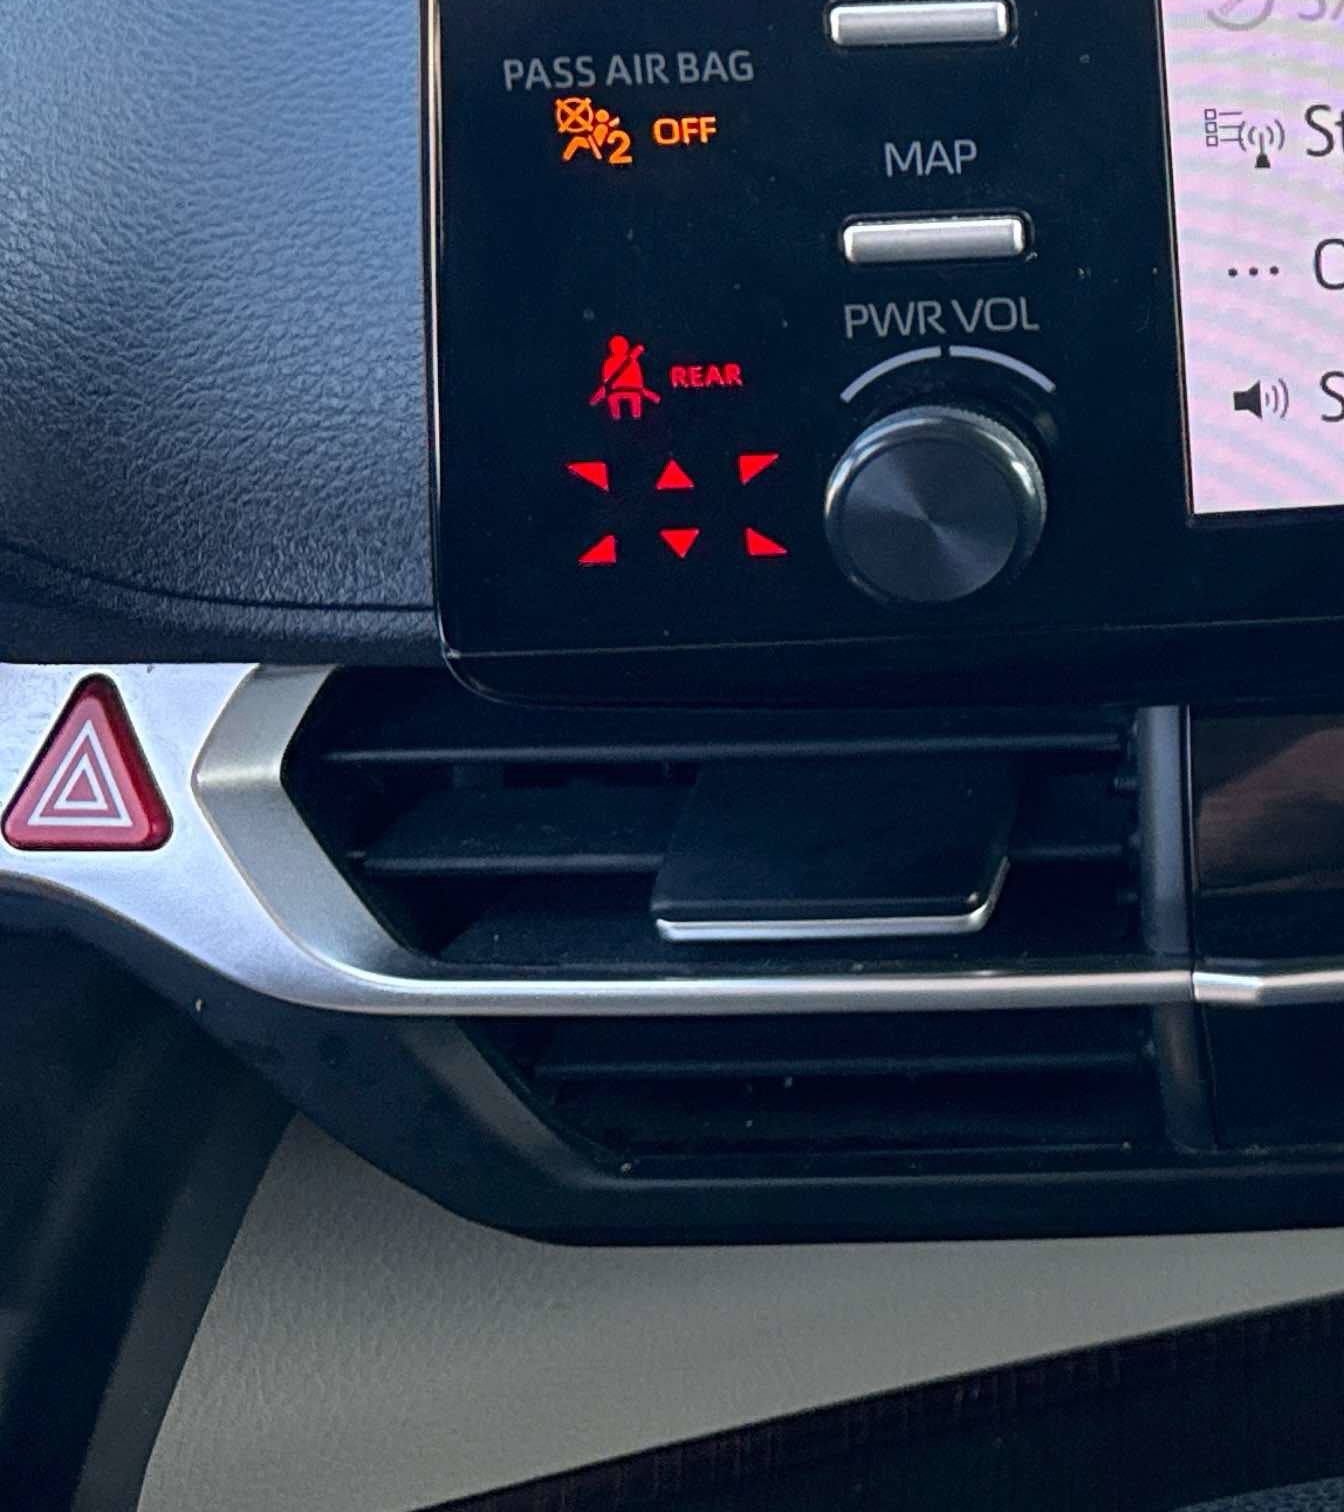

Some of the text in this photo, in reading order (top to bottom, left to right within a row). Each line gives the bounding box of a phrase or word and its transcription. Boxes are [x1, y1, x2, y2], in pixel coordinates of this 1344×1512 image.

[503, 49, 755, 91] PASS AIR BAG
[652, 115, 717, 146] OFF
[884, 139, 978, 177] MAP
[843, 296, 1040, 339] PWR VOL
[670, 363, 744, 389] REAR
